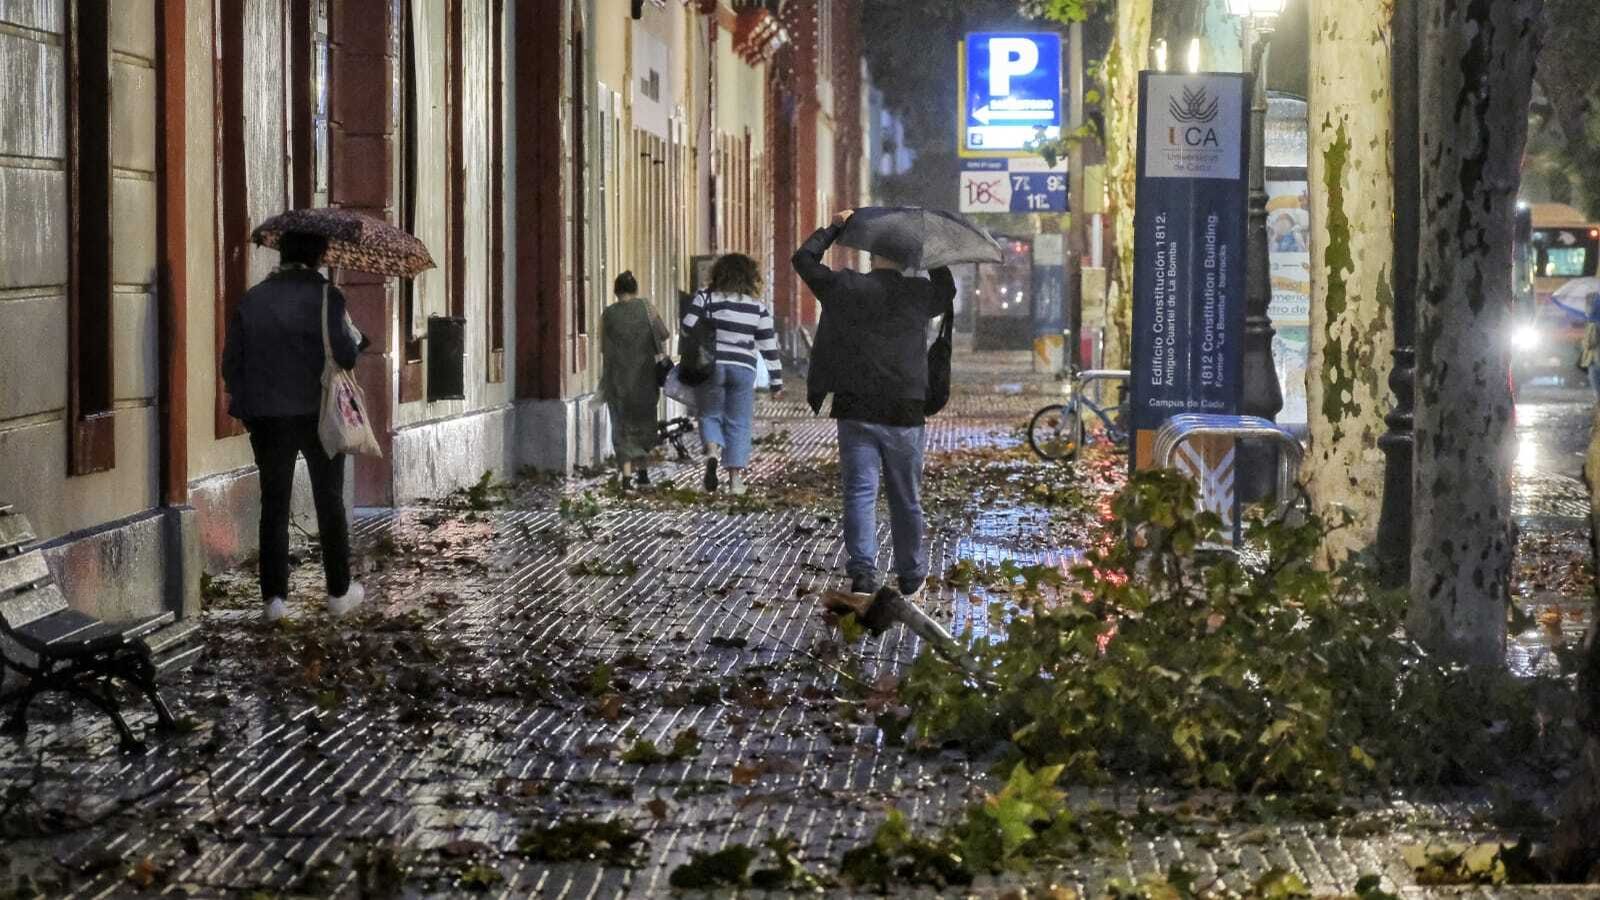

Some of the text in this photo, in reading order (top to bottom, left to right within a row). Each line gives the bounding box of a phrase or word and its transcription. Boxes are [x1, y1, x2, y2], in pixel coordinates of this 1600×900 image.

[988, 37, 1039, 96] P
[1151, 211, 1166, 386] Edificio Constitución 1812.
[1165, 241, 1177, 386] Antiguo Cuartel de La Bomba
[1202, 272, 1215, 352] Constitution
[1148, 398, 1184, 408] Campus
[1201, 355, 1213, 386] 1812
